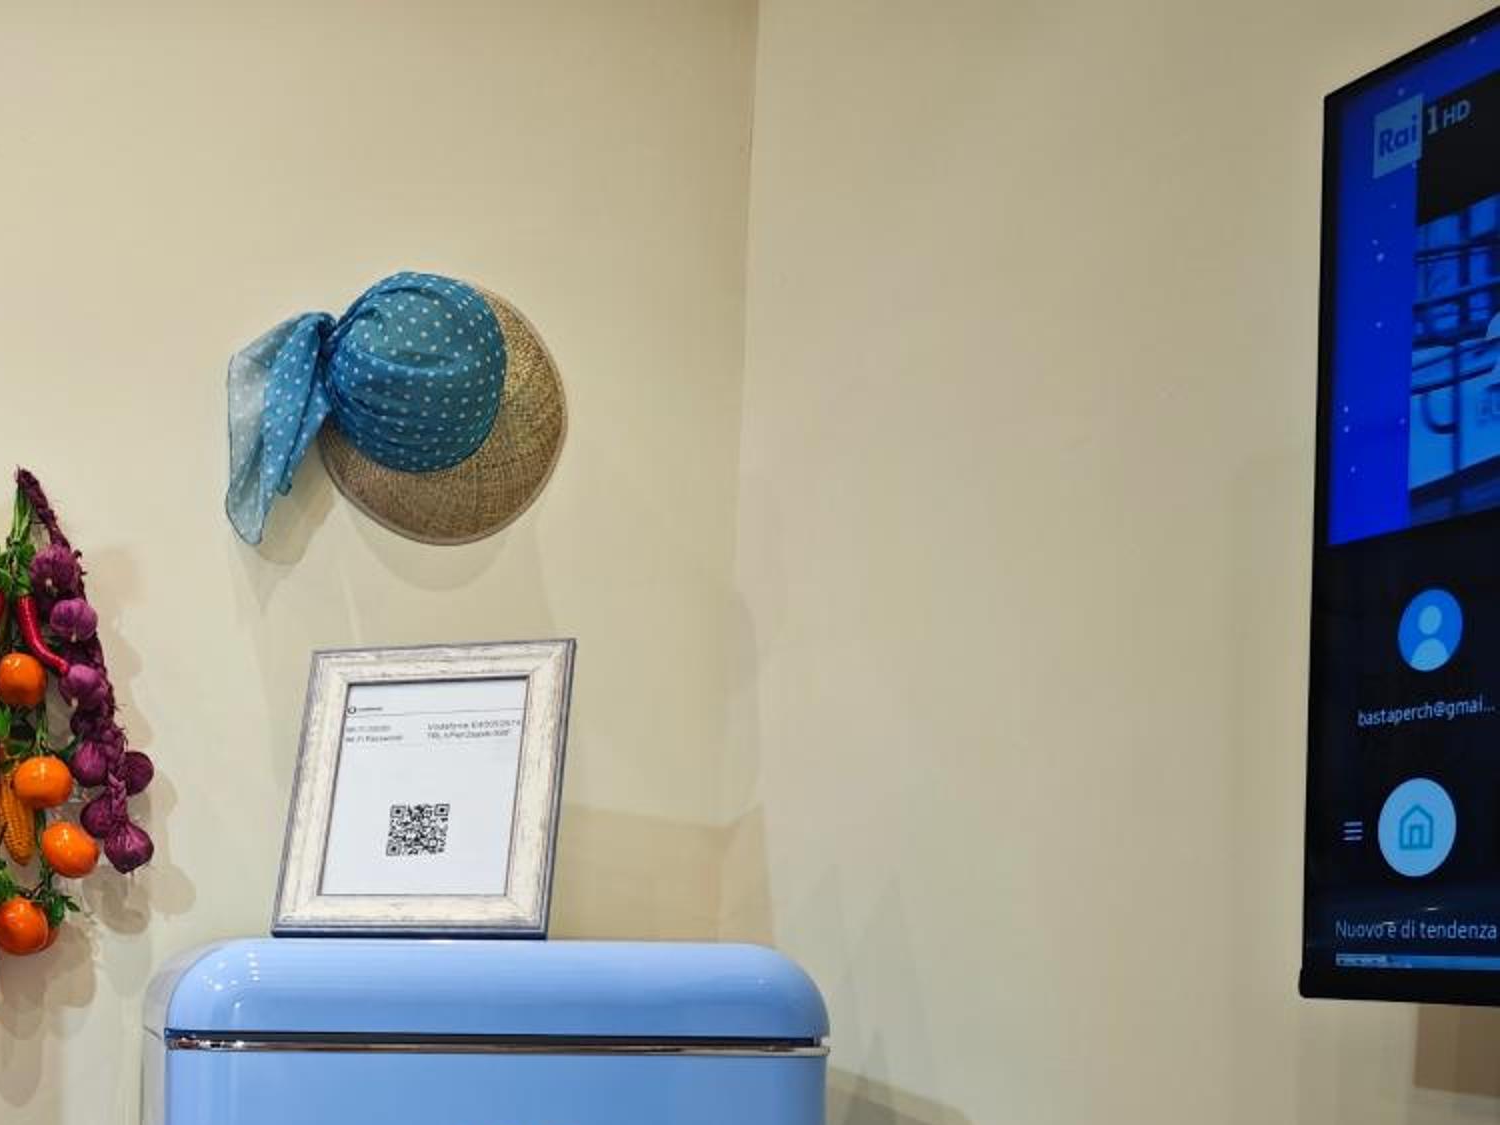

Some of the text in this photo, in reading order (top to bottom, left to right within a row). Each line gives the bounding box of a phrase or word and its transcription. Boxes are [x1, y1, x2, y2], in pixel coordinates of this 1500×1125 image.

[1379, 113, 1418, 158] Rai
[1443, 99, 1471, 128] HD
[1335, 920, 1384, 939] Nuovo
[1401, 919, 1415, 939] di
[1419, 919, 1498, 940] tendenza
